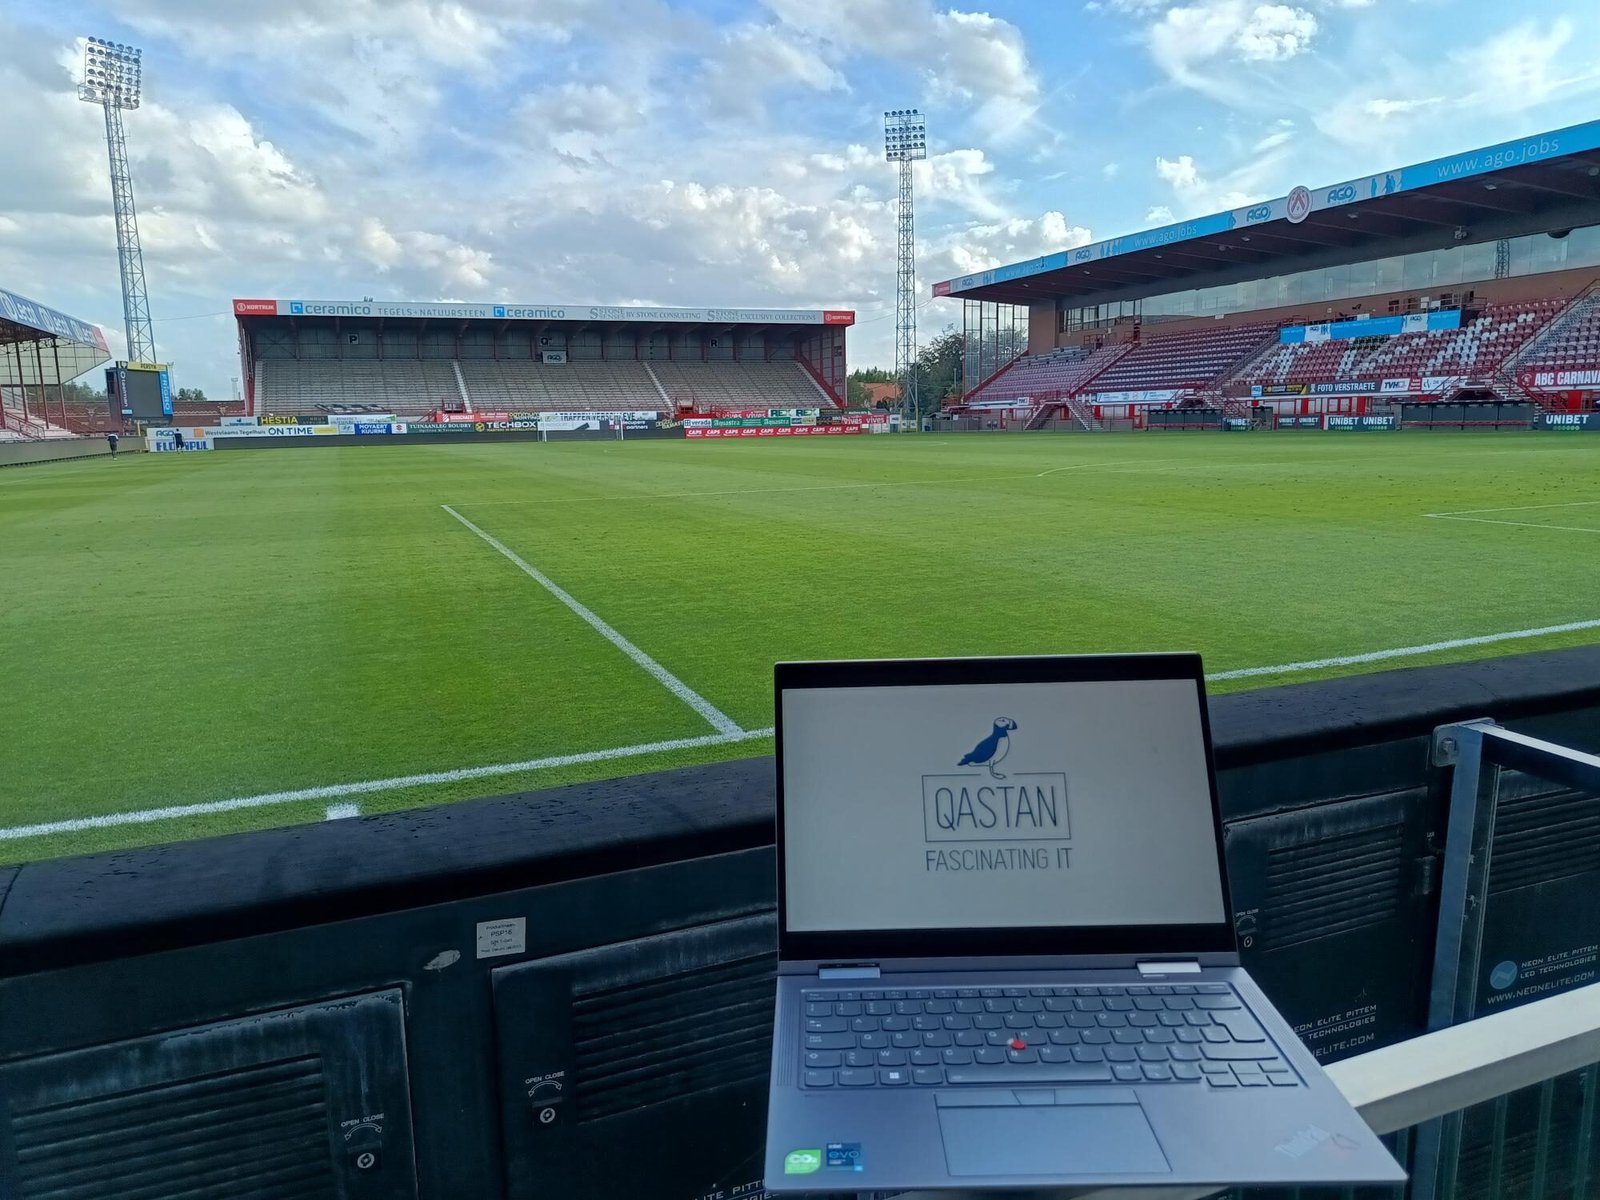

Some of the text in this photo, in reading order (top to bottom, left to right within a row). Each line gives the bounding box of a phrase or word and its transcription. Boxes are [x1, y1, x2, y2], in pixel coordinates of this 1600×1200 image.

[1437, 138, 1560, 177] www.ago.jobs
[1328, 185, 1355, 203] AGO
[1246, 206, 1271, 221] AGO
[1134, 224, 1197, 248] www.ago.jobs
[1075, 249, 1090, 261] AGO
[305, 303, 371, 315] ceramico
[506, 306, 565, 318] ceramico
[659, 311, 701, 319] CONSULTING
[349, 335, 358, 344] P
[711, 339, 718, 347] R
[1534, 372, 1555, 386] ABC
[1335, 382, 1376, 391] VERSTRAETE
[560, 412, 591, 420] TRAPPEN
[770, 409, 793, 417] REX
[261, 416, 298, 424] HESTIA
[713, 419, 740, 427] Aquastra
[763, 418, 790, 426] Aquastra
[844, 417, 863, 425] vives
[866, 416, 885, 424] vives
[1330, 416, 1359, 425] UNIBET
[1363, 416, 1394, 425] UNIBET
[1545, 414, 1590, 424] UNIBET
[486, 421, 536, 429] TECHBOX
[268, 427, 284, 435] ON
[286, 427, 313, 435] TIME
[935, 785, 1057, 831] QASTAN
[925, 847, 1073, 872] FASCINATING IT
[1521, 944, 1599, 968] NEON ELITE PITTEM
[1520, 954, 1597, 979] LED TECHNOLOGIES
[1487, 970, 1595, 1005] WWW.NEONELITE.COM
[1293, 1004, 1377, 1033] EON ELITE PITTEM
[1308, 1015, 1376, 1040] TECHNOLOGIES
[524, 1070, 565, 1084] OPEN CLOSE
[340, 1112, 385, 1128] OPEN CLOSE
[829, 1151, 860, 1159] evo
